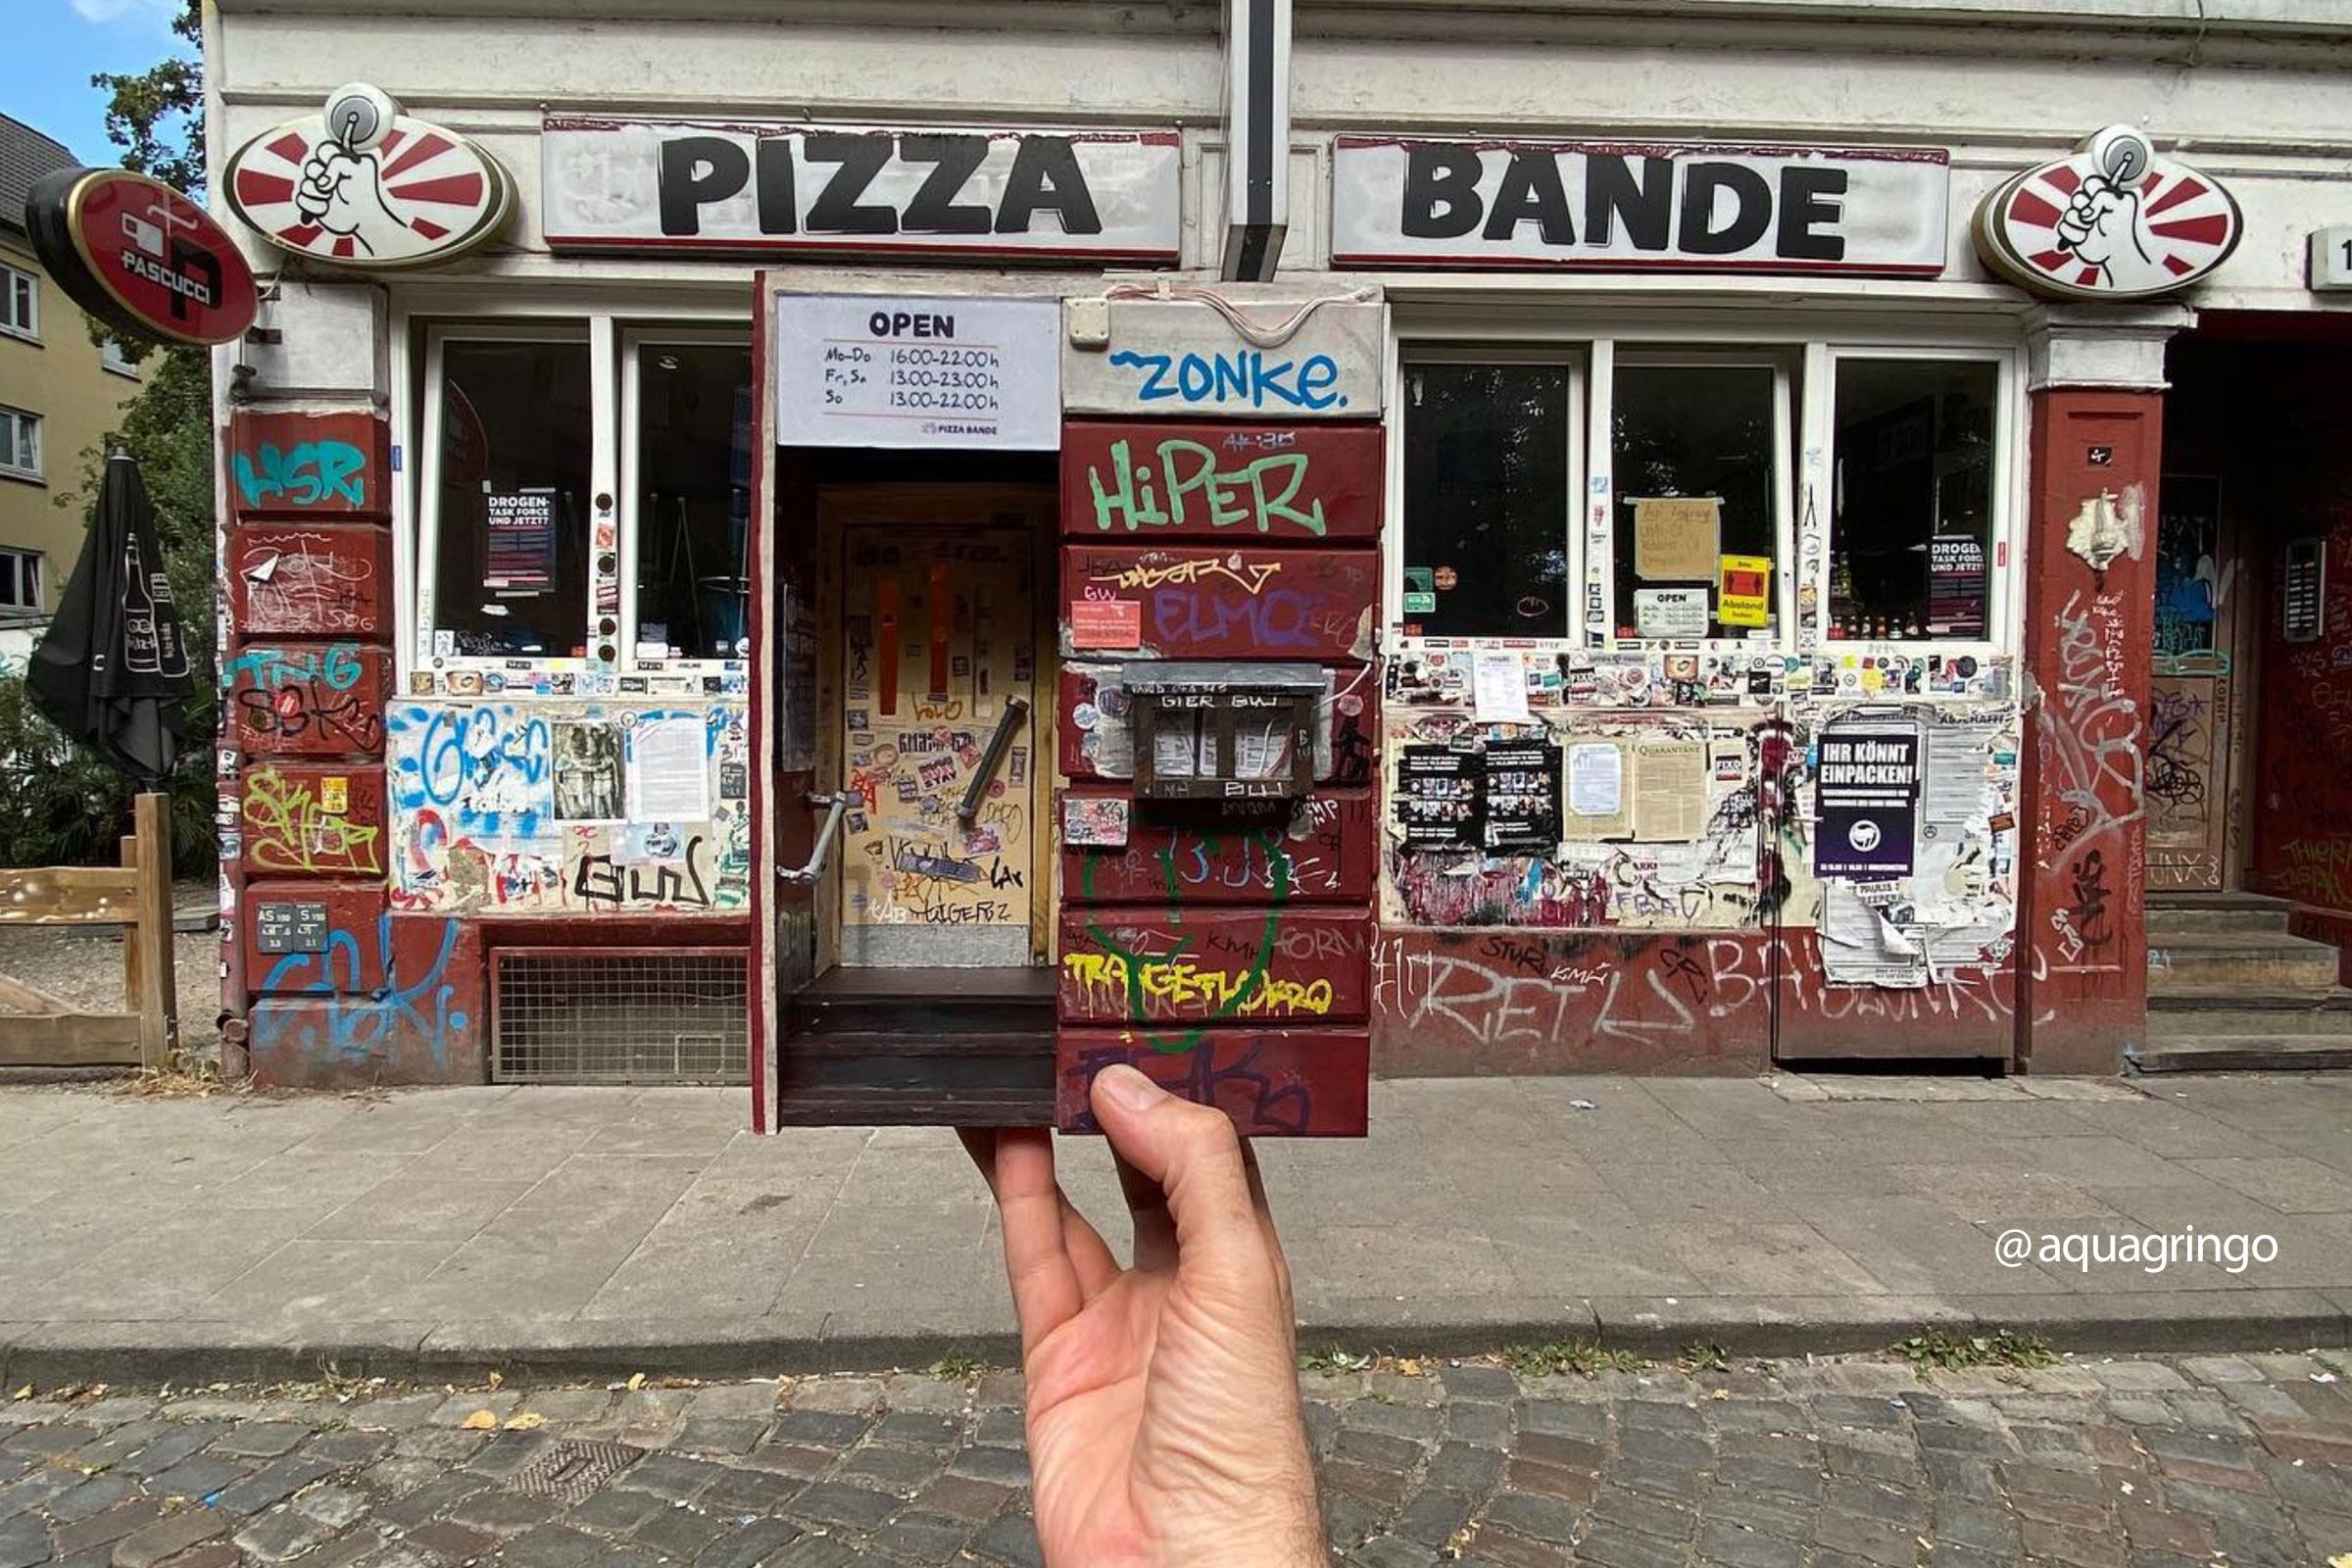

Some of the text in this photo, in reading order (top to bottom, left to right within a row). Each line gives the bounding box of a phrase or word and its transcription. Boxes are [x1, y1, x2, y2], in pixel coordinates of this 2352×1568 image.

[660, 135, 1102, 236] PIZZA
[1401, 142, 1849, 262] BANDE
[122, 247, 211, 306] PASCUCCI
[868, 311, 955, 338] OPEN
[825, 347, 871, 363] Mo-Do
[825, 389, 843, 404] So
[489, 496, 551, 508] DROGEN-
[489, 508, 549, 516] TASK FORCE
[489, 516, 550, 525] UND JETZT?
[1932, 555, 1957, 564] TASK
[1932, 564, 1953, 572] UND
[1656, 593, 1688, 604] OPEN
[1823, 740, 1910, 762] IHR KÖNNT
[1820, 764, 1914, 784] EINPACKEN!
